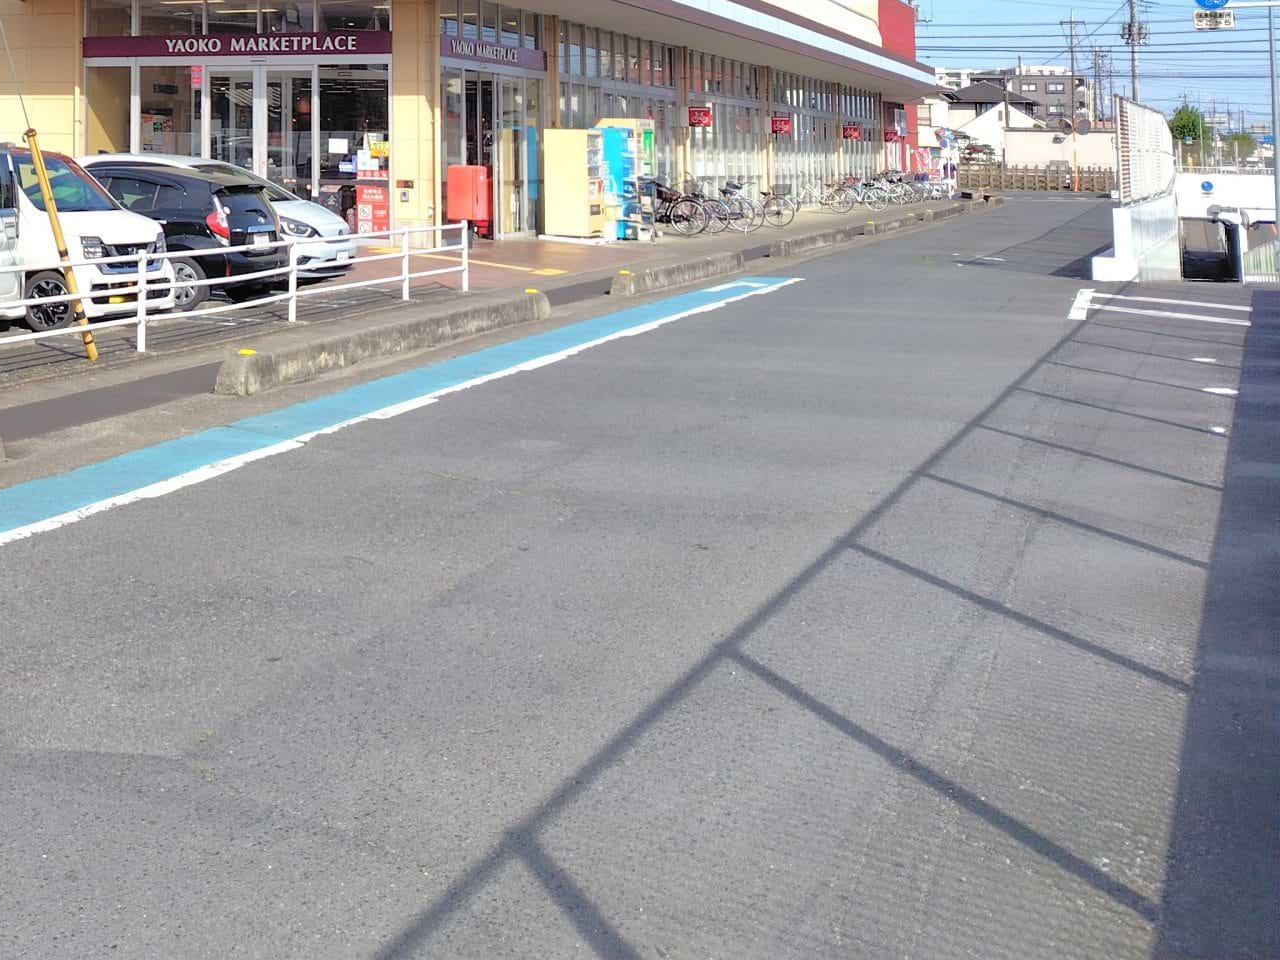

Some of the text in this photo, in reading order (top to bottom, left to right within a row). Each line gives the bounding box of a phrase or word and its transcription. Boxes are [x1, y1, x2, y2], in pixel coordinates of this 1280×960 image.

[165, 36, 357, 53] YAOKO MARKETPLACE
[452, 39, 518, 62] YAOKO MARKETPLACE
